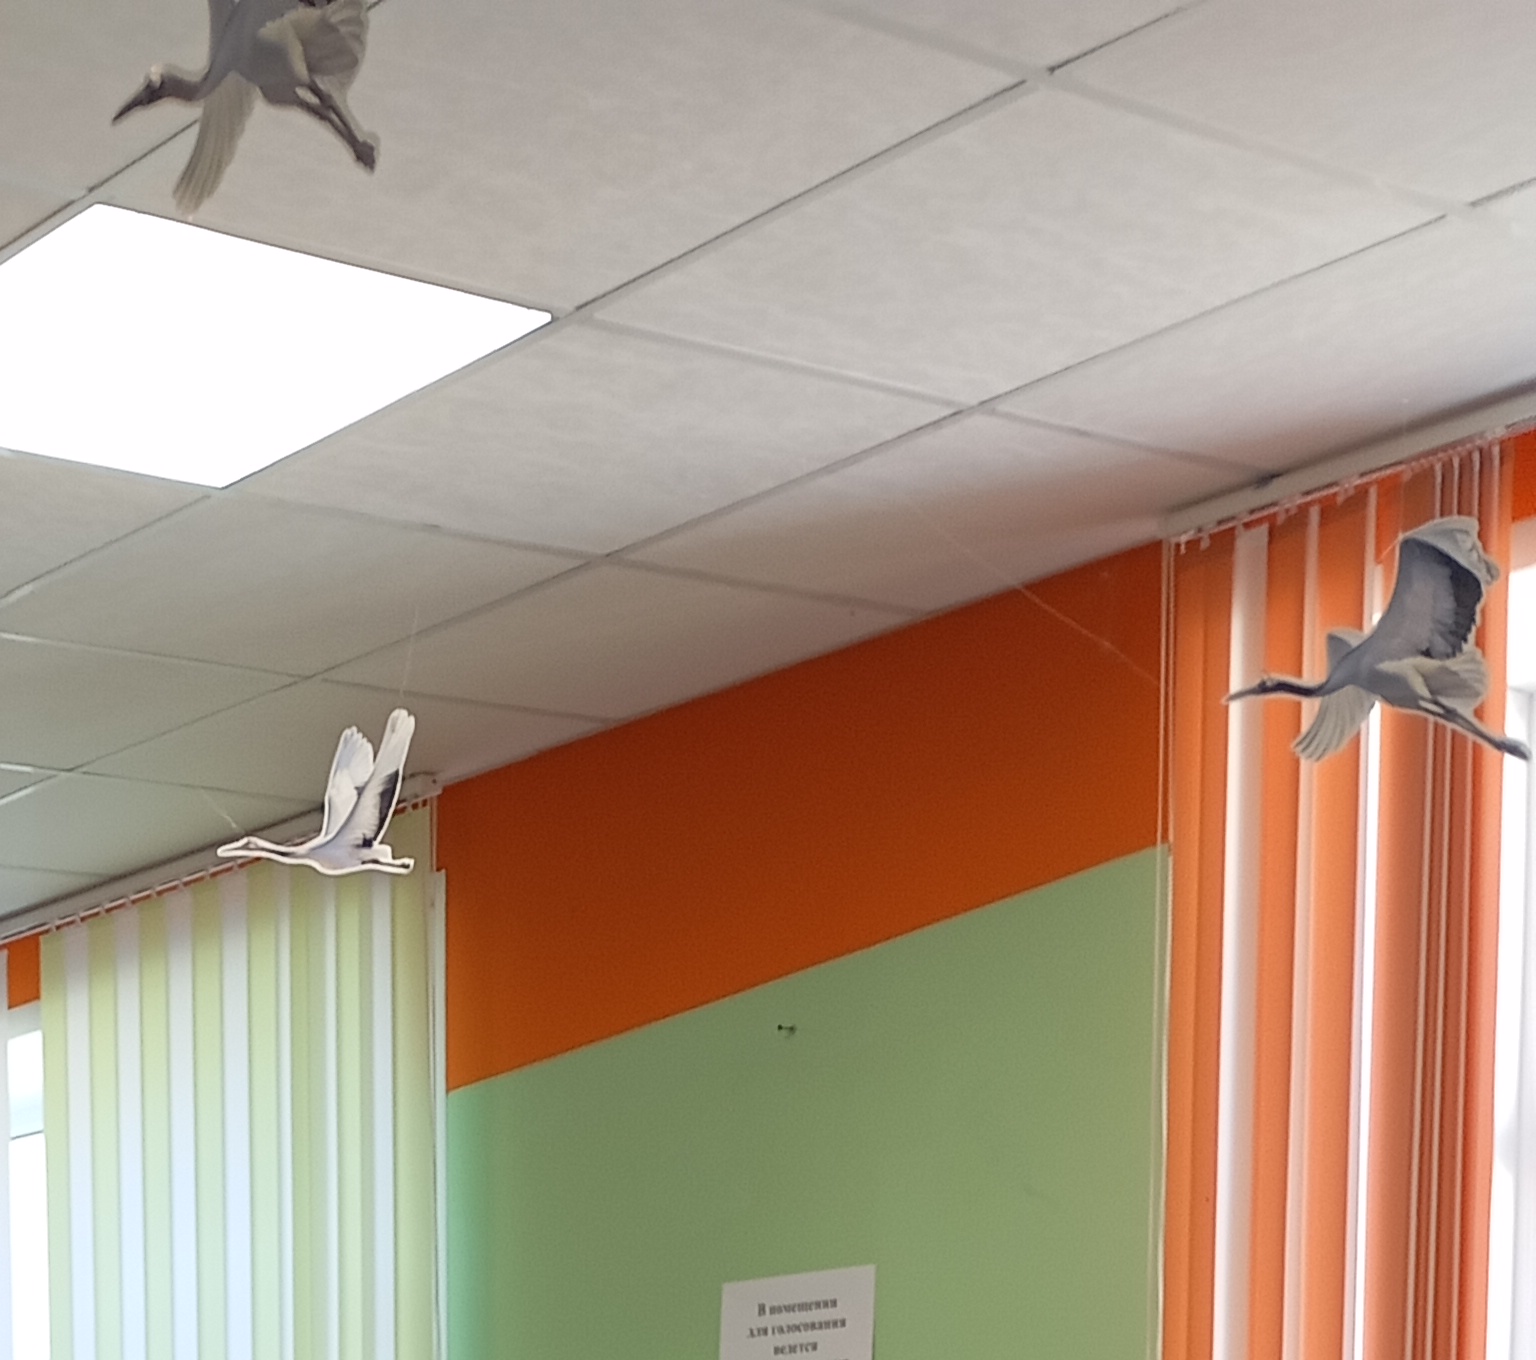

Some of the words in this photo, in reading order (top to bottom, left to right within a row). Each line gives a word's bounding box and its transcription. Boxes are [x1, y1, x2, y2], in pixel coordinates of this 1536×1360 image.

[758, 1302, 766, 1317] В
[770, 1299, 837, 1315] помещении
[747, 1326, 768, 1338] для
[771, 1318, 846, 1336] голосования
[774, 1342, 818, 1355] ведется
